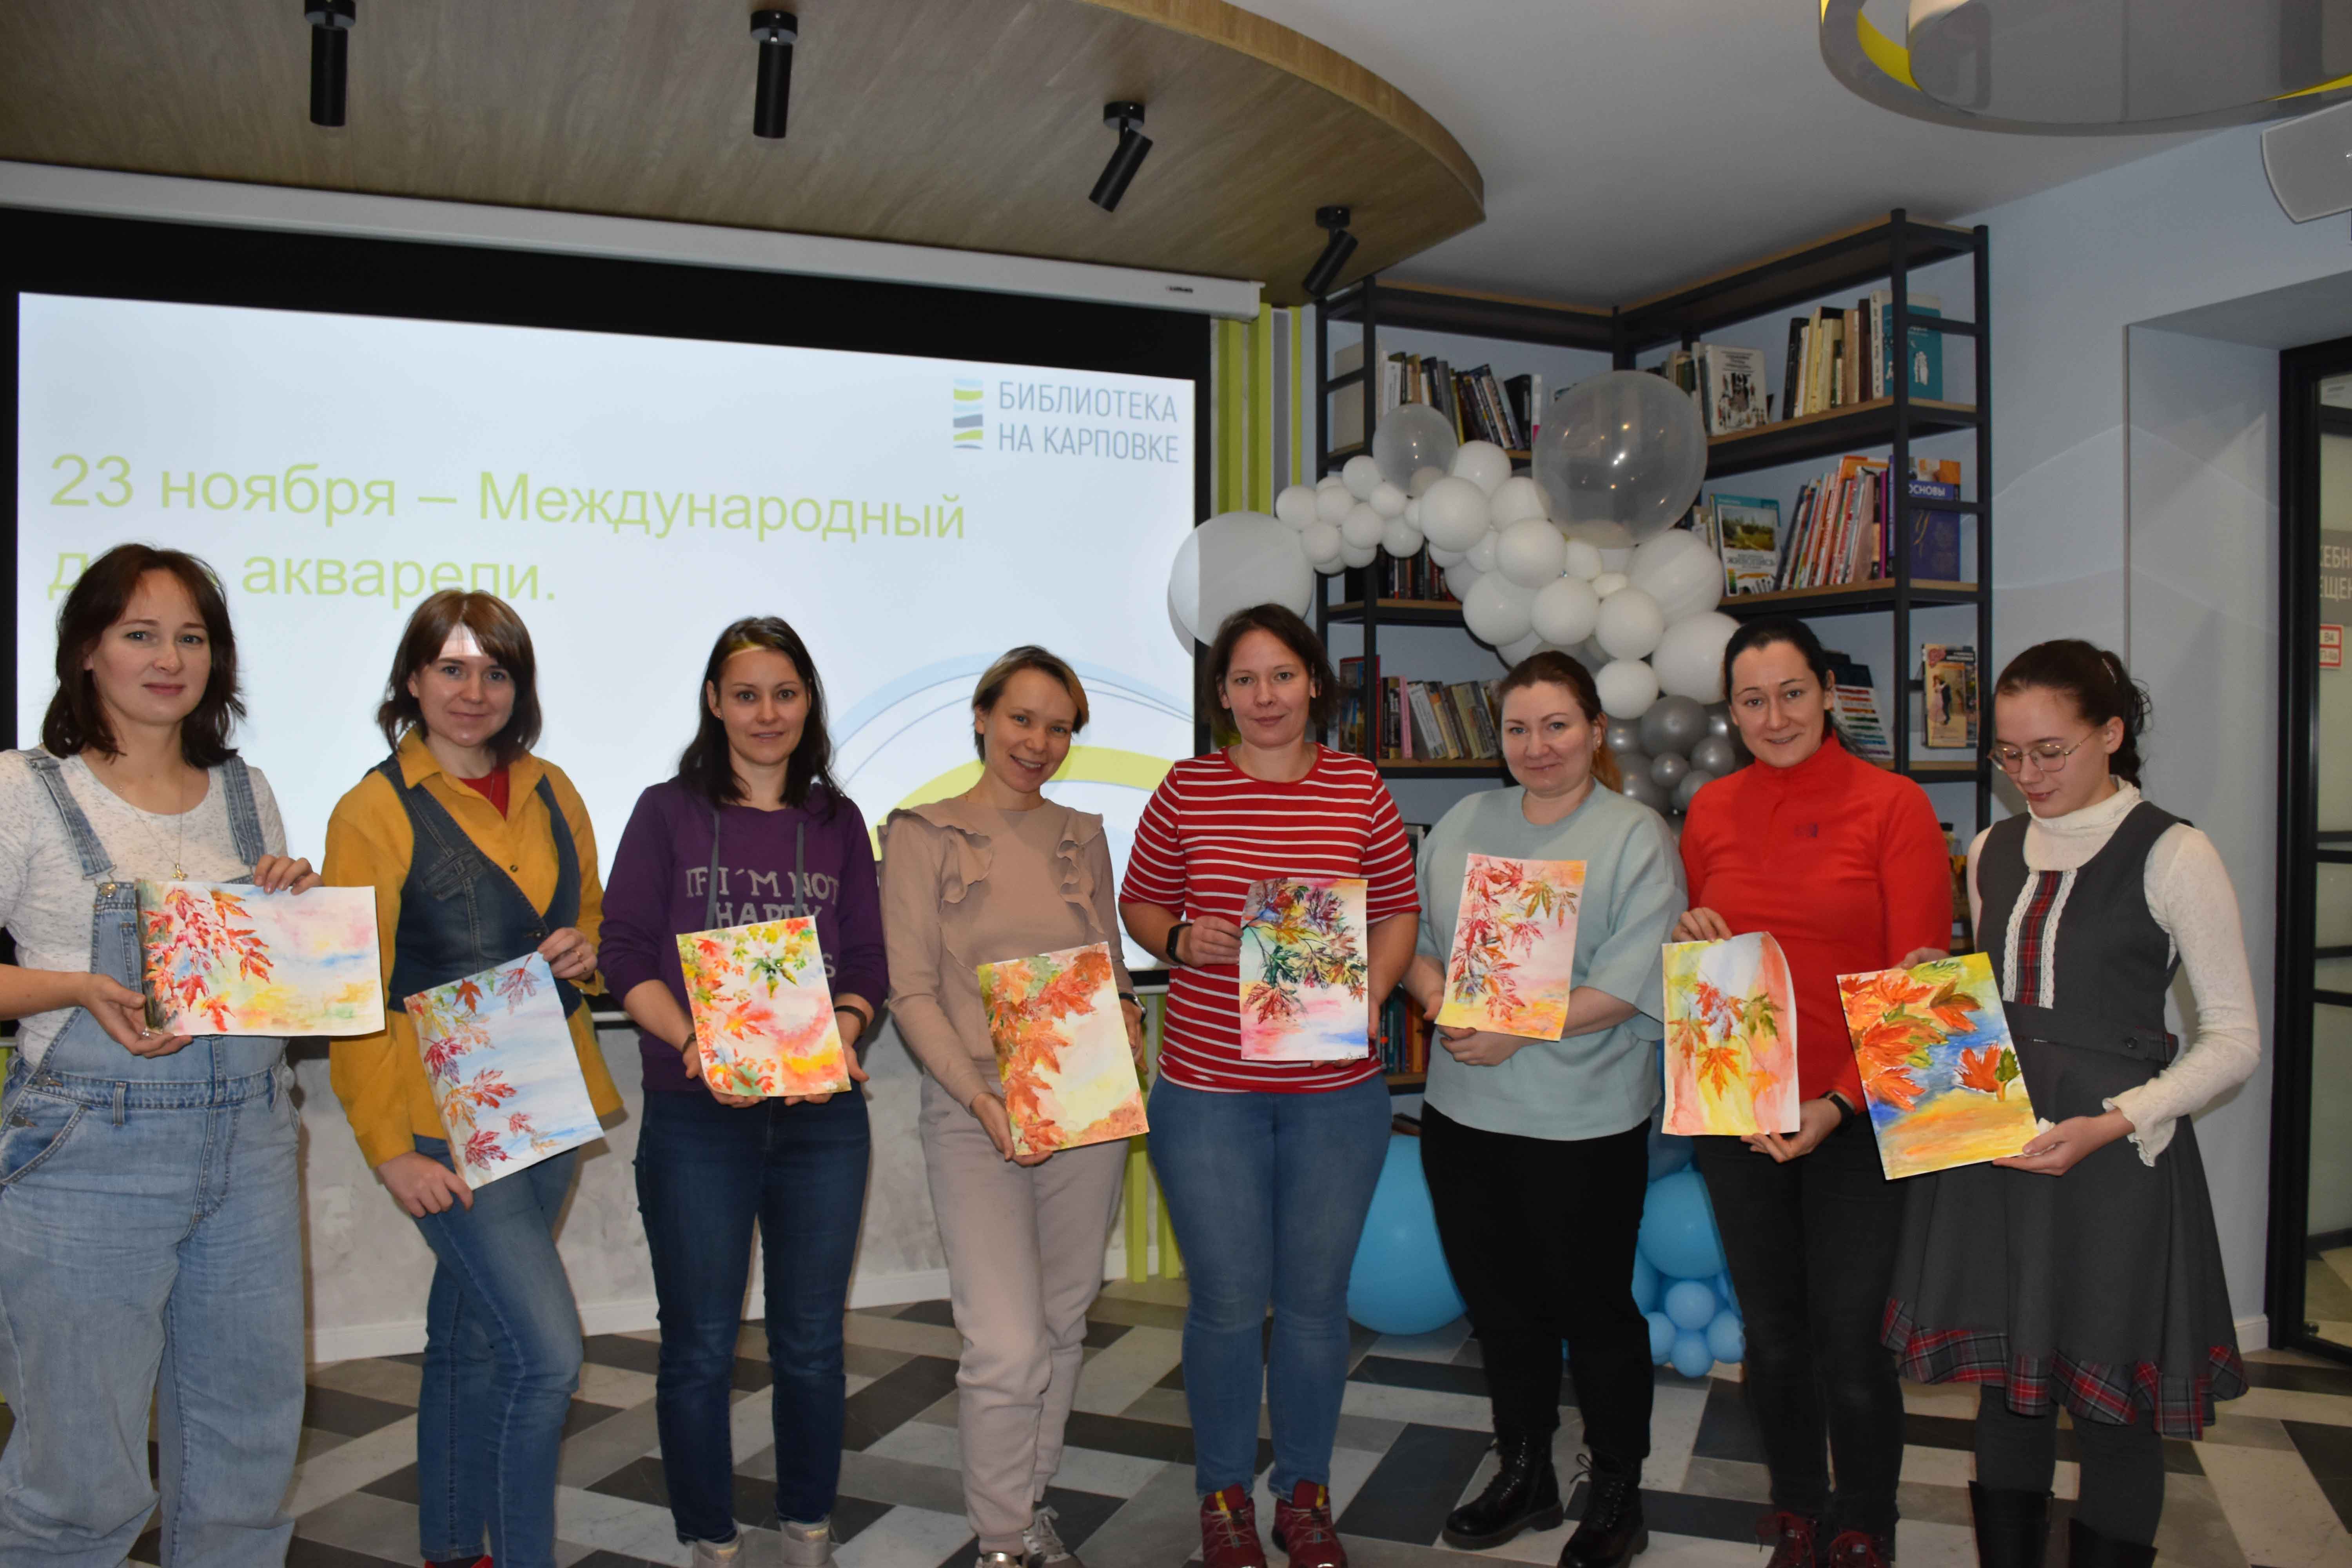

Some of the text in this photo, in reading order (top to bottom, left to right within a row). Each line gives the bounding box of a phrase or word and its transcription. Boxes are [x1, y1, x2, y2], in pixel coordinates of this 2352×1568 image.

[1000, 381, 1178, 423] БИБЛИОТЕКА
[998, 423, 1179, 463] НА КАРПОВКЕ
[49, 453, 134, 508] 23
[160, 463, 396, 528] ноября
[479, 471, 964, 541] Международный
[686, 866, 708, 898] IF
[787, 871, 840, 906] NOT
